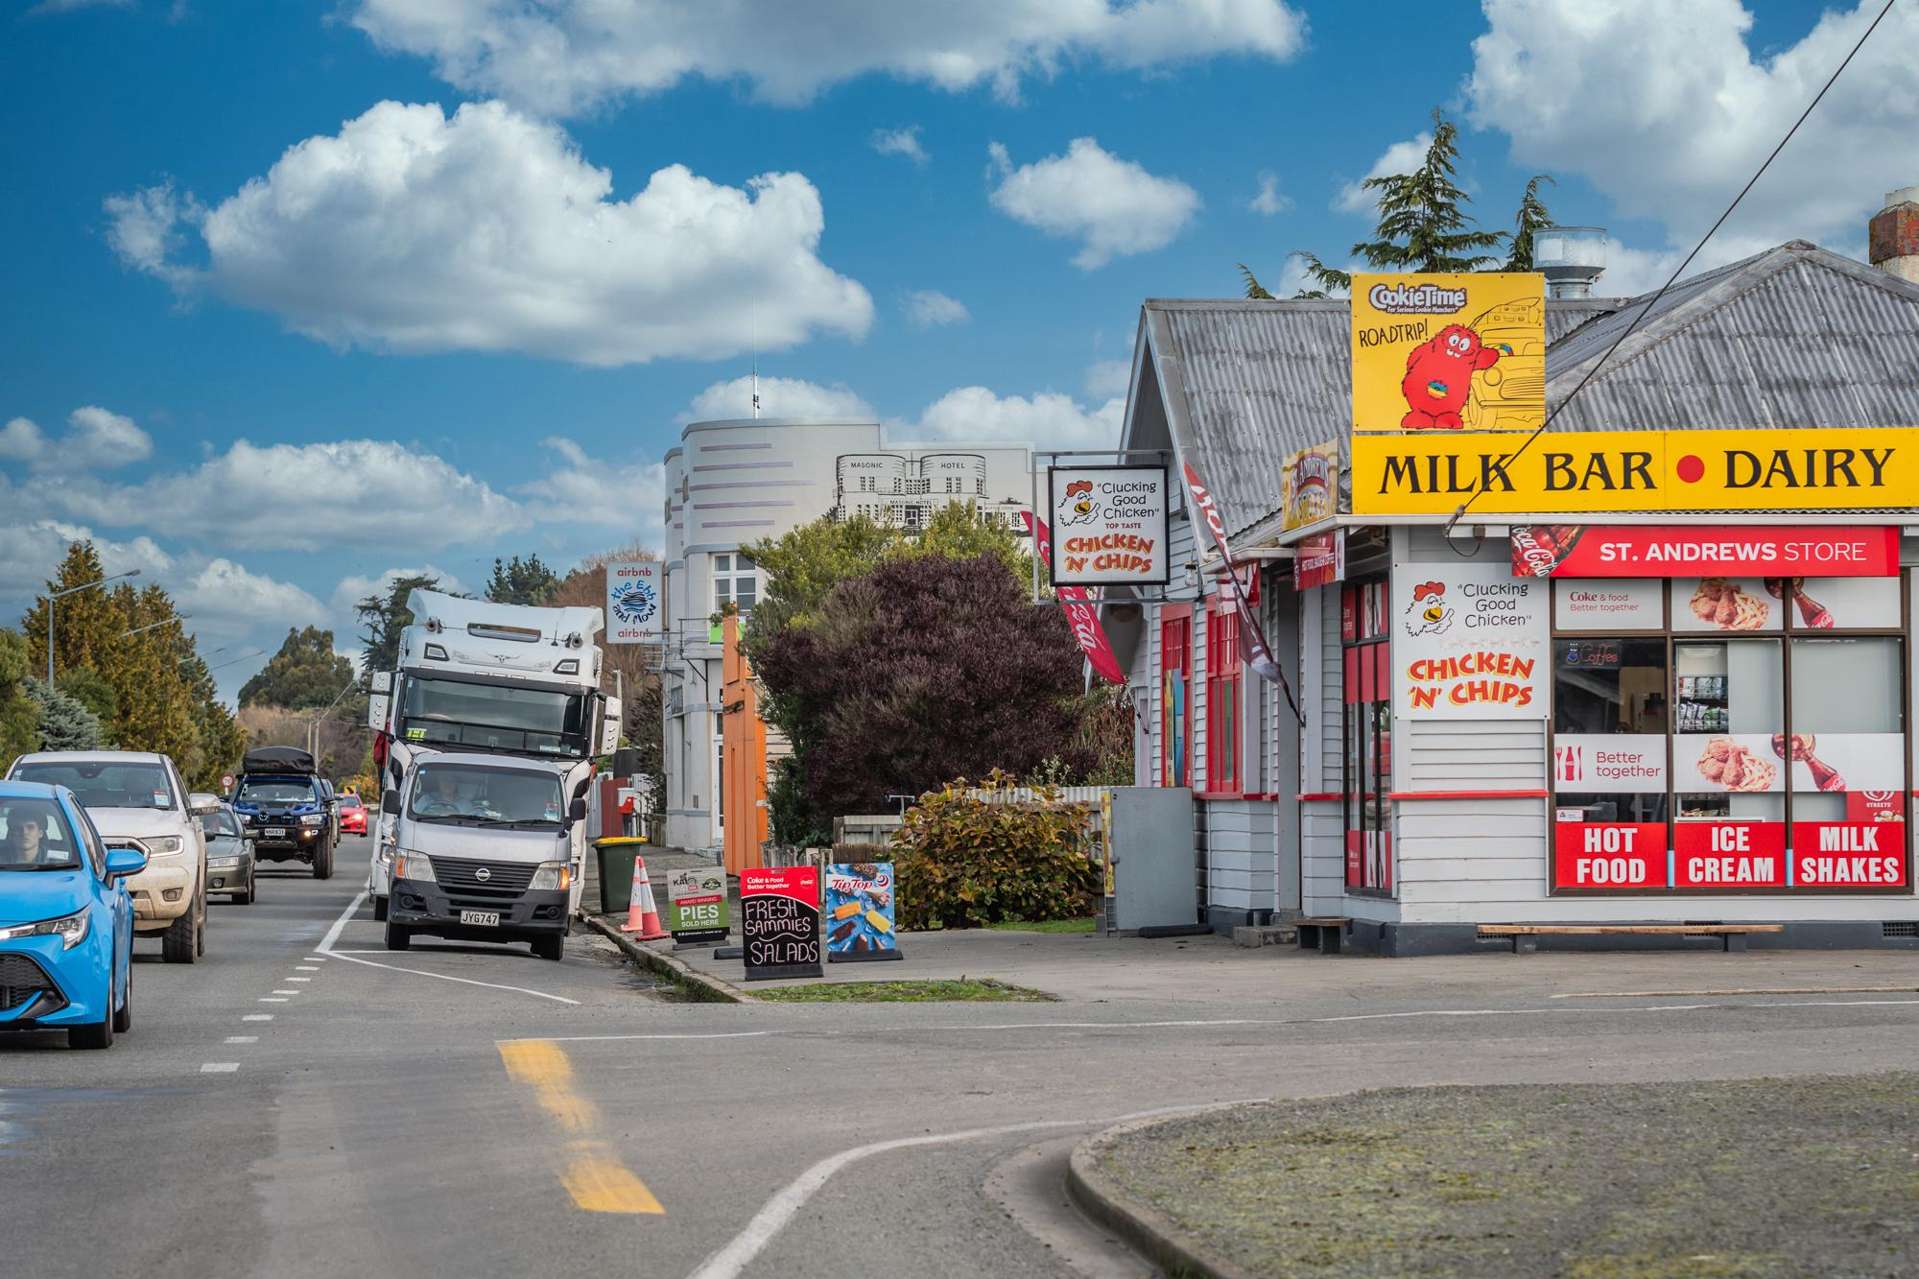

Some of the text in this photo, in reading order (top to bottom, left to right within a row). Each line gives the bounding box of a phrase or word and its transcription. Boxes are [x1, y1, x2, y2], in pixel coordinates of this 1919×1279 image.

[1370, 284, 1466, 309] CookieTime
[1359, 318, 1429, 348] ROADTRIP!
[1377, 454, 1516, 494] MILK
[1542, 452, 1658, 491] BAR
[1723, 448, 1896, 488] DAIRY
[1112, 495, 1147, 506] Good
[1064, 533, 1155, 554] CHICKEN
[1600, 542, 1868, 562] ST. ANDREWS STORE
[617, 567, 652, 577] airbnb
[1092, 553, 1153, 574] CHIPS
[611, 580, 657, 600] the Ebb
[1570, 591, 1598, 602] Coke
[1608, 593, 1628, 602] food
[612, 604, 631, 623] and
[1475, 599, 1516, 612] Good
[1570, 603, 1639, 613] Better together
[1408, 652, 1535, 681] CHICKEN
[1449, 680, 1534, 706] CHIPS
[1597, 752, 1643, 763] Better
[1597, 765, 1661, 779] together
[1584, 828, 1638, 852] HOT
[1712, 826, 1750, 852] ICE
[1820, 827, 1879, 851] MILK
[1576, 858, 1645, 883] FOOD
[1689, 857, 1775, 883] CREAM
[1801, 857, 1899, 883] SHAKES
[462, 912, 498, 924] JYG747
[680, 905, 719, 920] PIES
[745, 899, 798, 919] FRESH
[750, 941, 818, 965] SALADS
